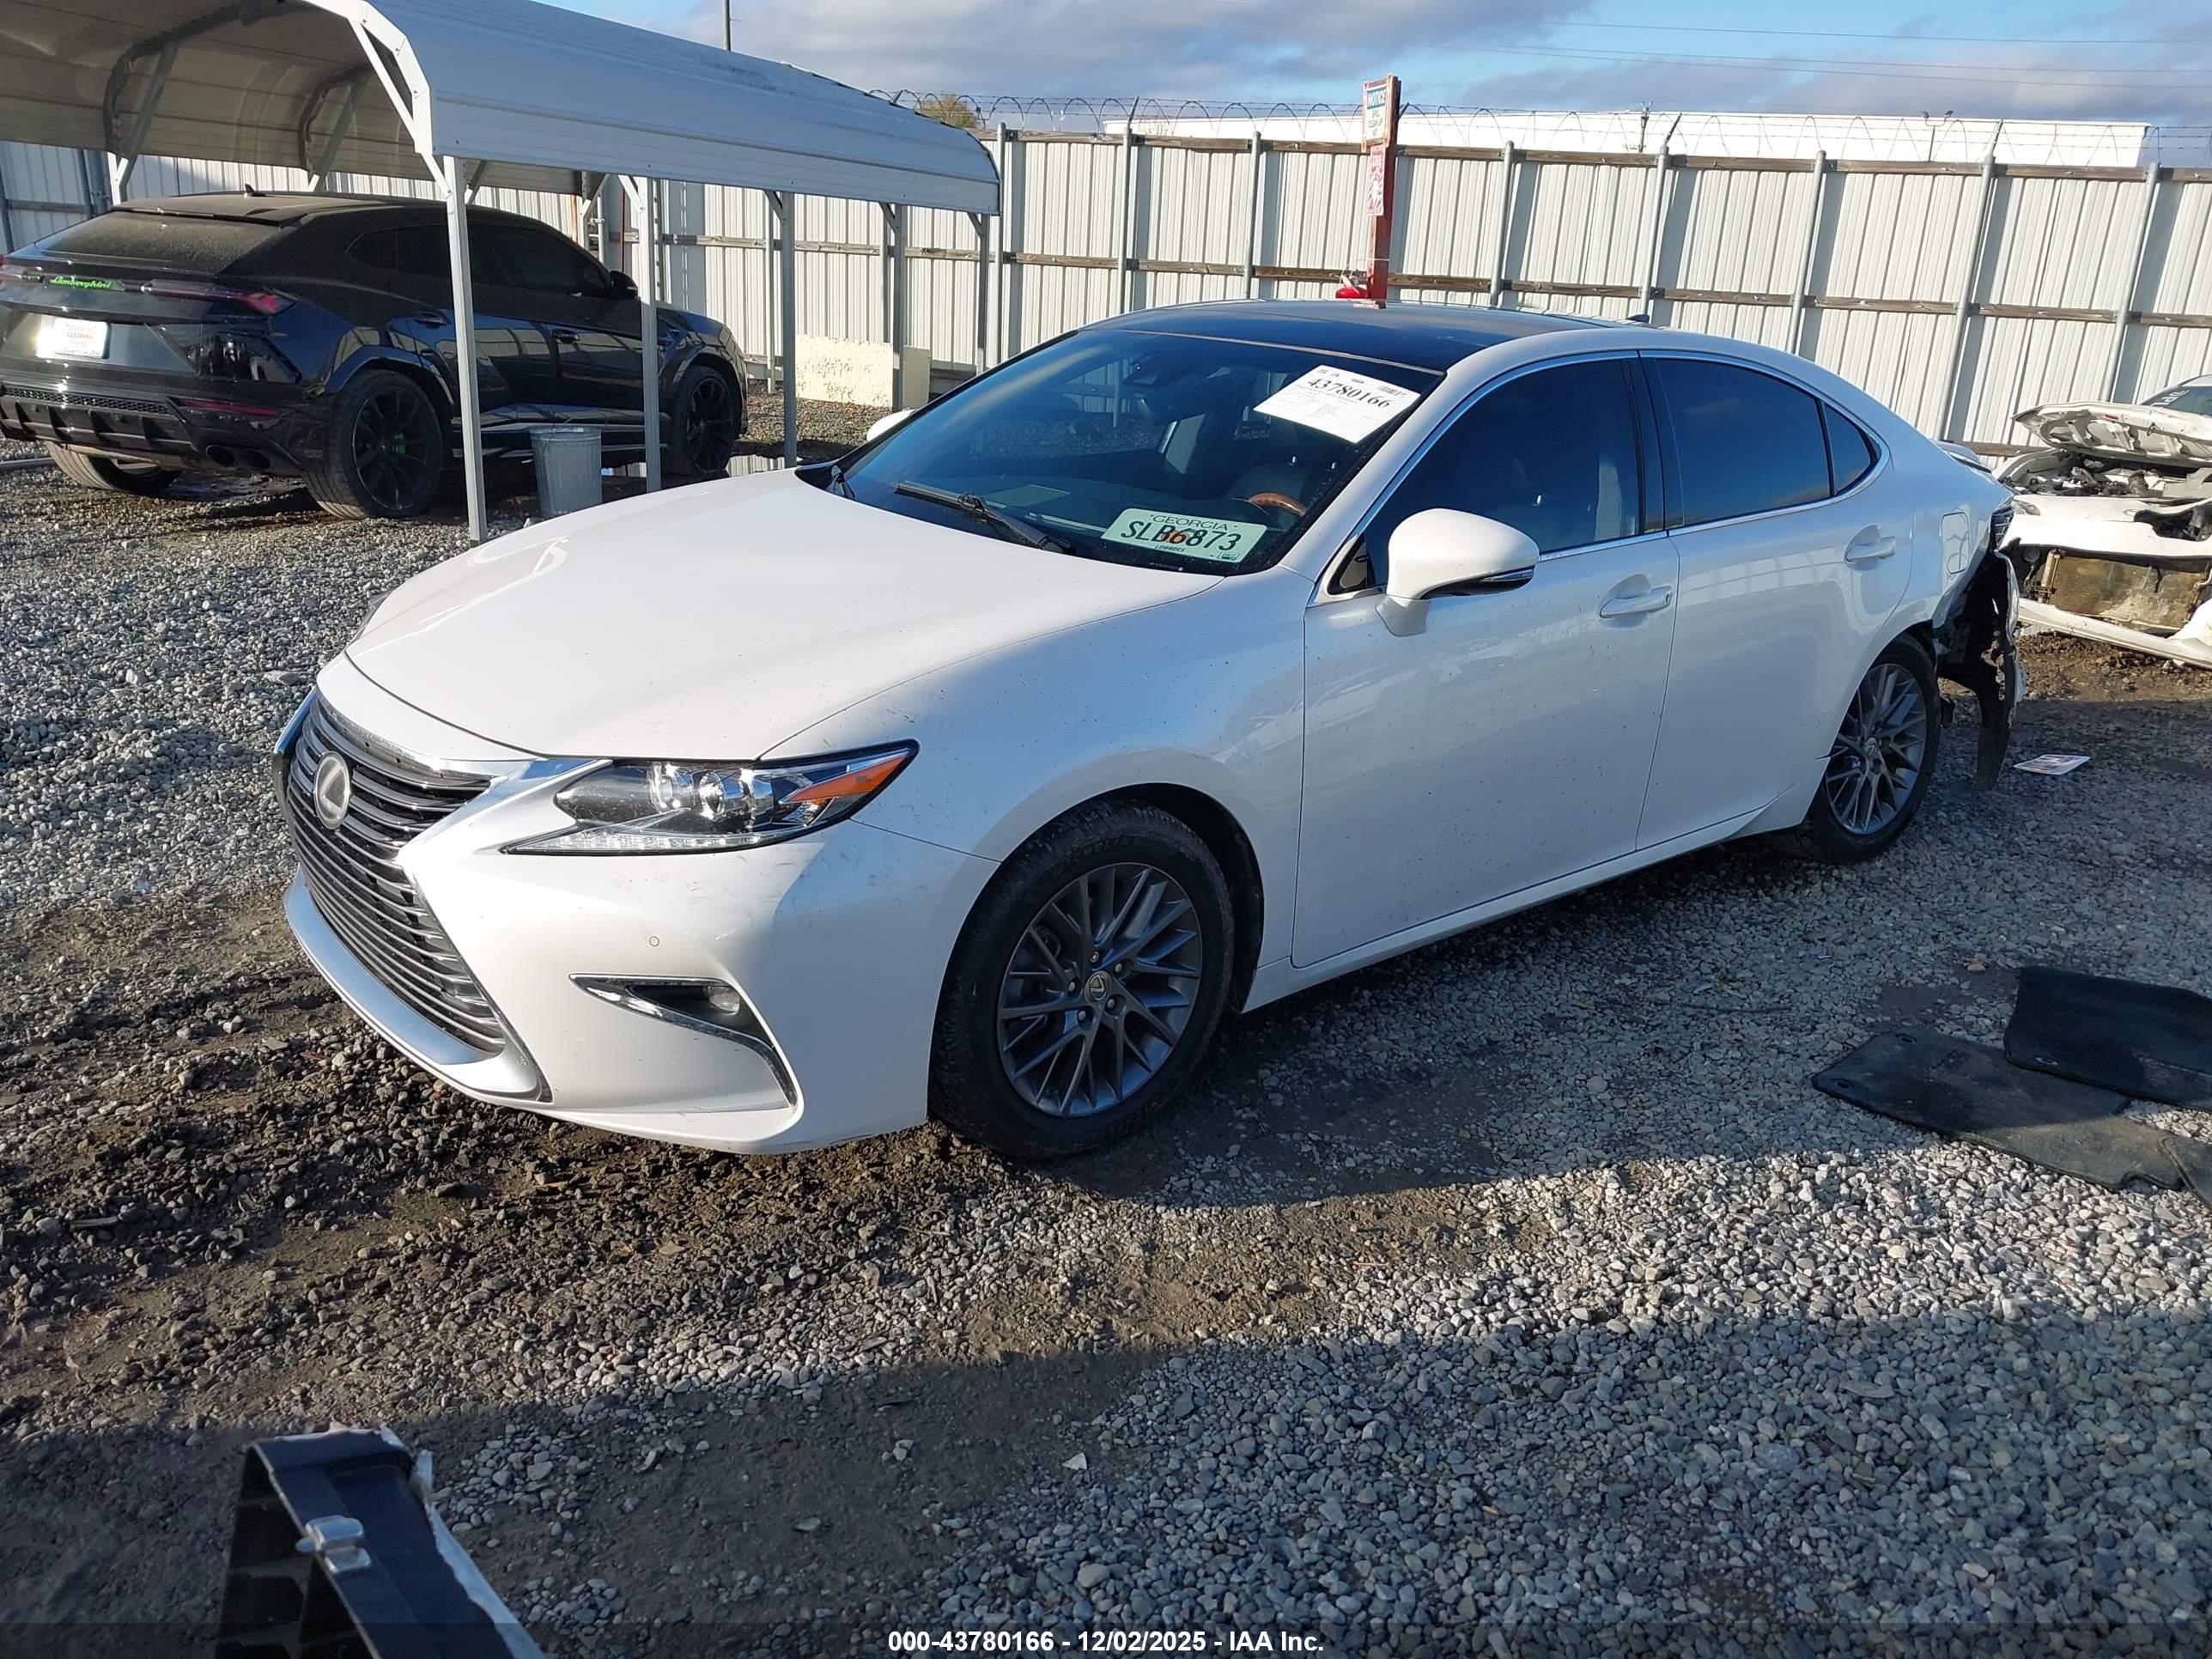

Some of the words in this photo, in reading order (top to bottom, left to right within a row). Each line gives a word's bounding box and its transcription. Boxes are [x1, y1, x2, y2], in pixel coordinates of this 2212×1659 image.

[1368, 88, 1387, 106] NOTICE
[50, 276, 112, 289] Lamborghini
[1307, 378, 1395, 408] 43780166
[1152, 514, 1228, 531] GEORGIA
[1121, 520, 1242, 551] SLB6873
